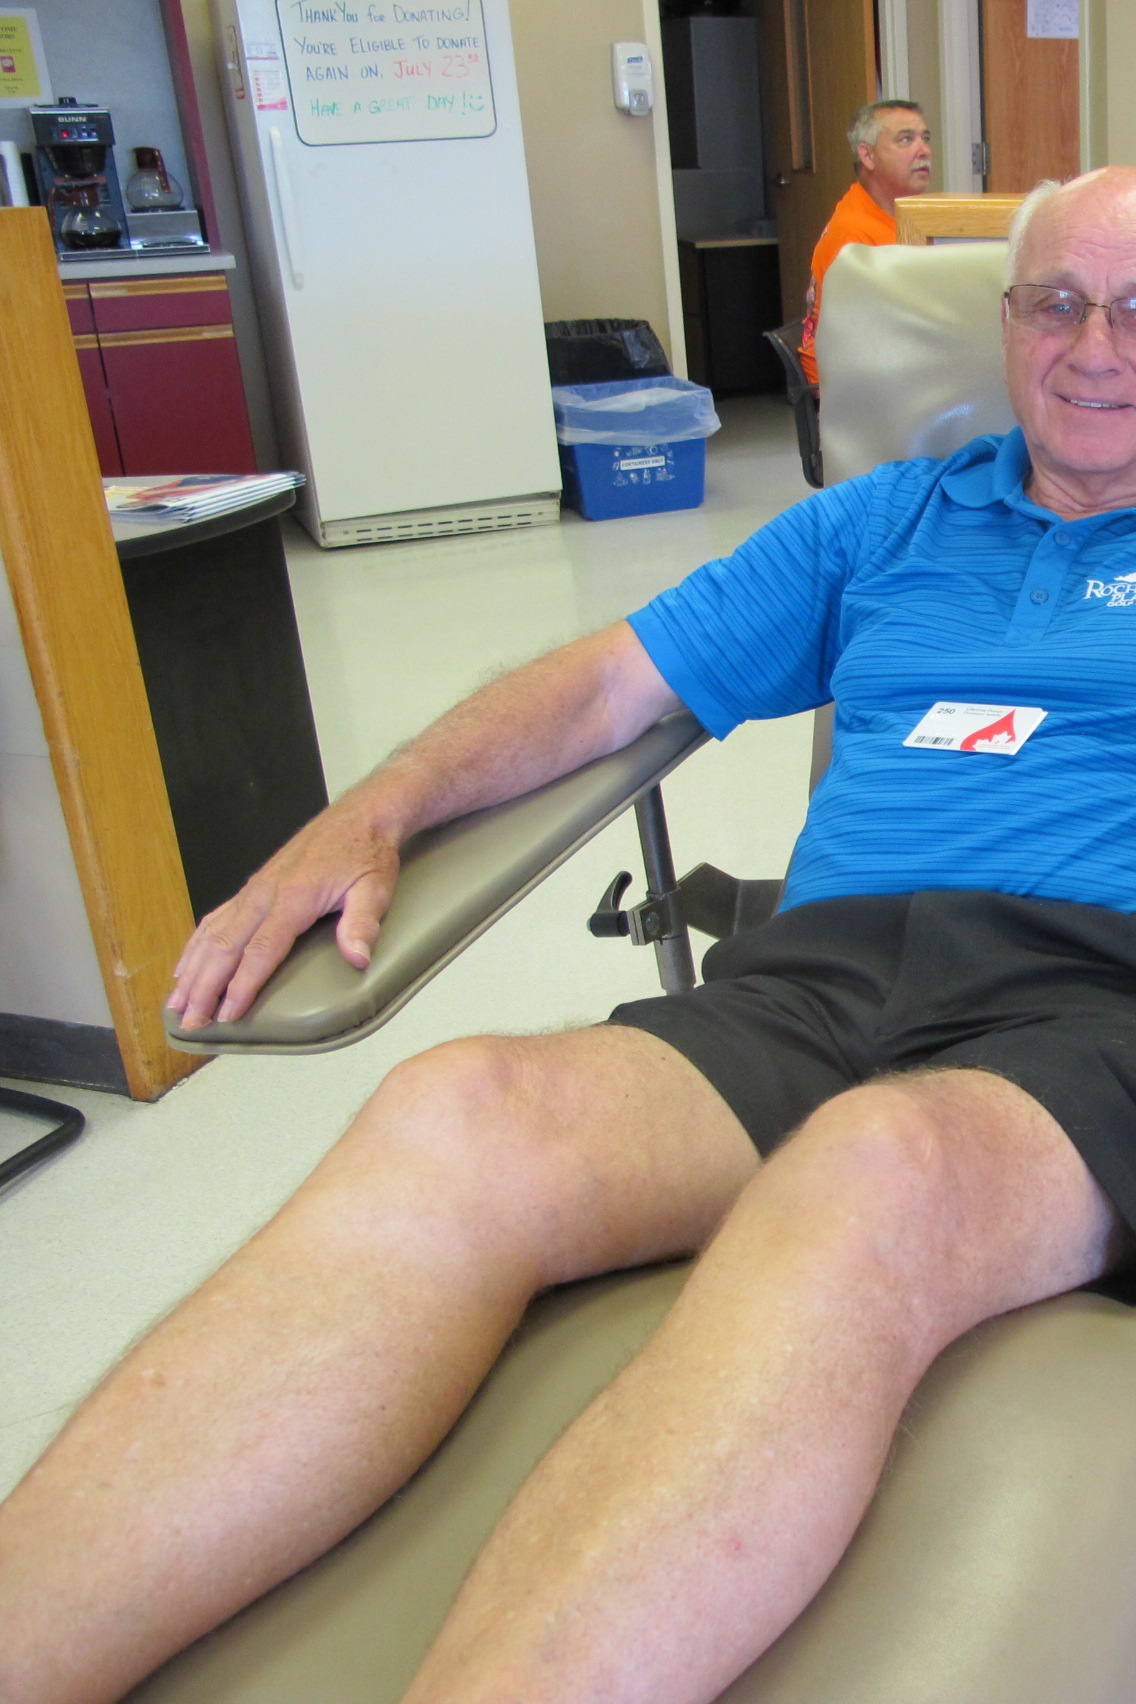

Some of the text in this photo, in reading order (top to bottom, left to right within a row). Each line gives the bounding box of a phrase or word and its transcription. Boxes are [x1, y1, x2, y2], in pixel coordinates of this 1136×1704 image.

[437, 37, 479, 49] DONATE
[306, 63, 349, 81] AGAIN
[393, 60, 432, 79] JULY
[57, 115, 87, 123] BUNN
[936, 707, 957, 715] 250
